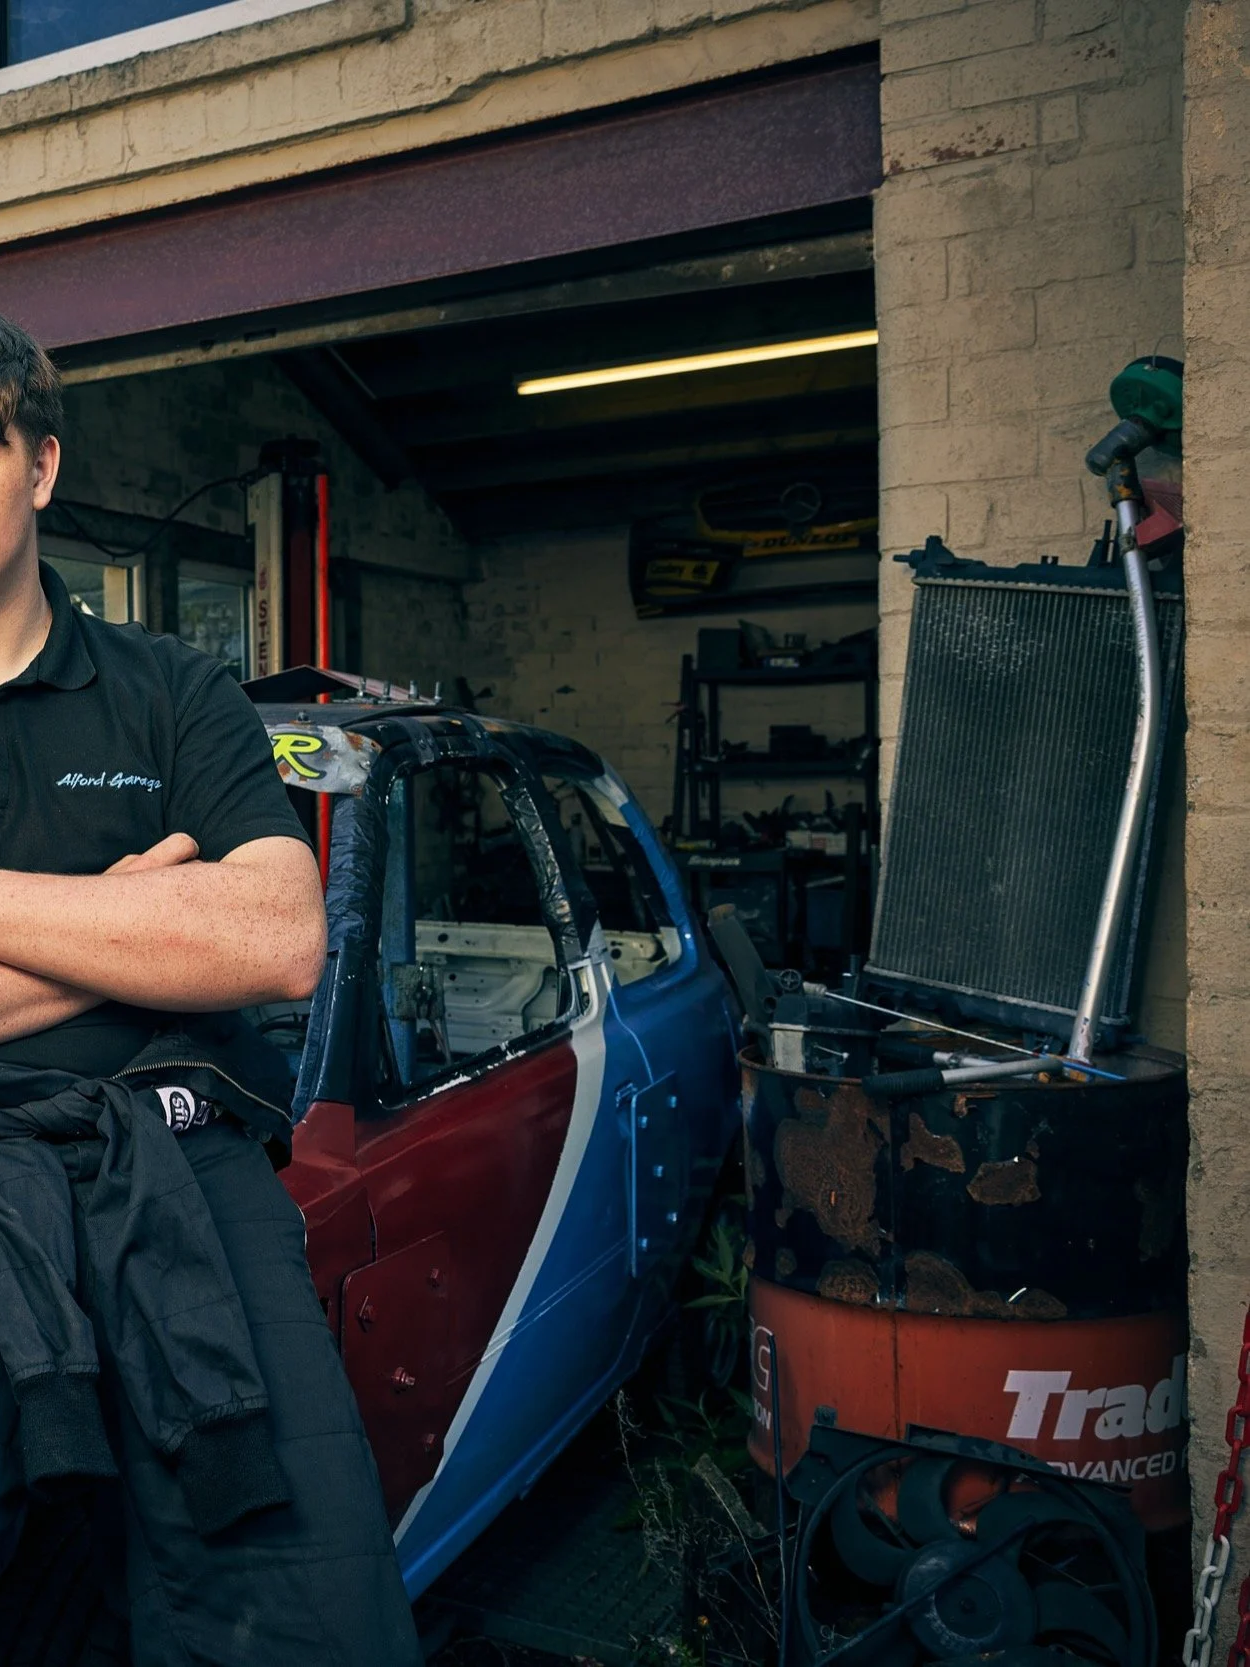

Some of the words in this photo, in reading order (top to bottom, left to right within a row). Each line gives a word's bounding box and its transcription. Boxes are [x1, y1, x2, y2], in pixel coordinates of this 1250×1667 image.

[56, 771, 106, 790] Alford
[107, 772, 162, 792] Garage
[1003, 1355, 1189, 1440] Trad
[1022, 1450, 1176, 1484] DVANCED
